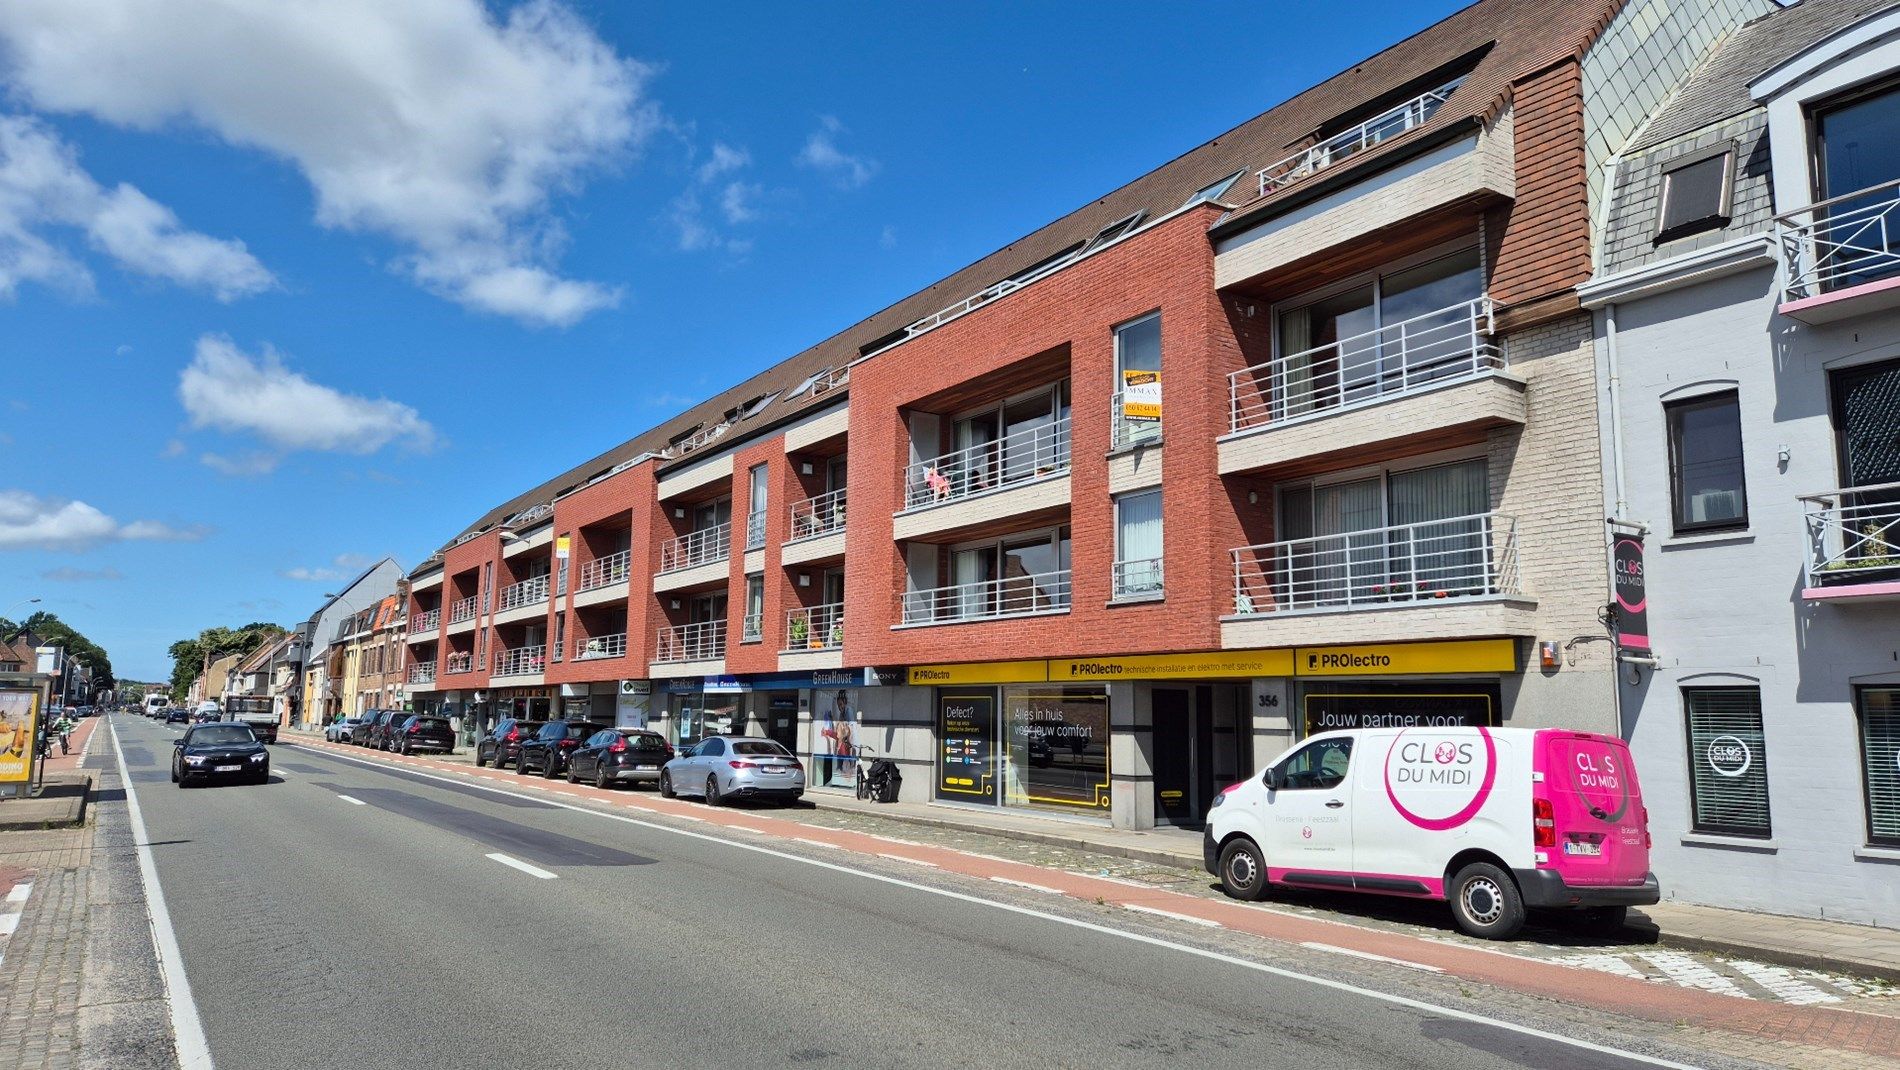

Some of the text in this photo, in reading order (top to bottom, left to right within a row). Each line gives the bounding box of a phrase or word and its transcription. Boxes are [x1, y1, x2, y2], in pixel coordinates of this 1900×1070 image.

[1616, 558, 1643, 575] CLOS
[1616, 574, 1645, 587] DU MIDI
[1322, 653, 1390, 668] PROlectro
[920, 670, 950, 680] PROlectro
[1080, 663, 1122, 675] PROlectro
[1222, 663, 1235, 671] met
[1236, 662, 1262, 670] service
[1258, 694, 1278, 707] 356
[946, 706, 974, 718] Defect?
[1014, 708, 1064, 720] Alles in huis
[1318, 710, 1465, 728] Jouw partner voor
[1034, 724, 1055, 738] jouw
[1056, 724, 1093, 738] comfort
[1401, 741, 1473, 765] CLOS
[1714, 746, 1742, 756] CLOS
[1397, 768, 1471, 785] DU MIDI
[1580, 773, 1619, 789] DU MIDI
